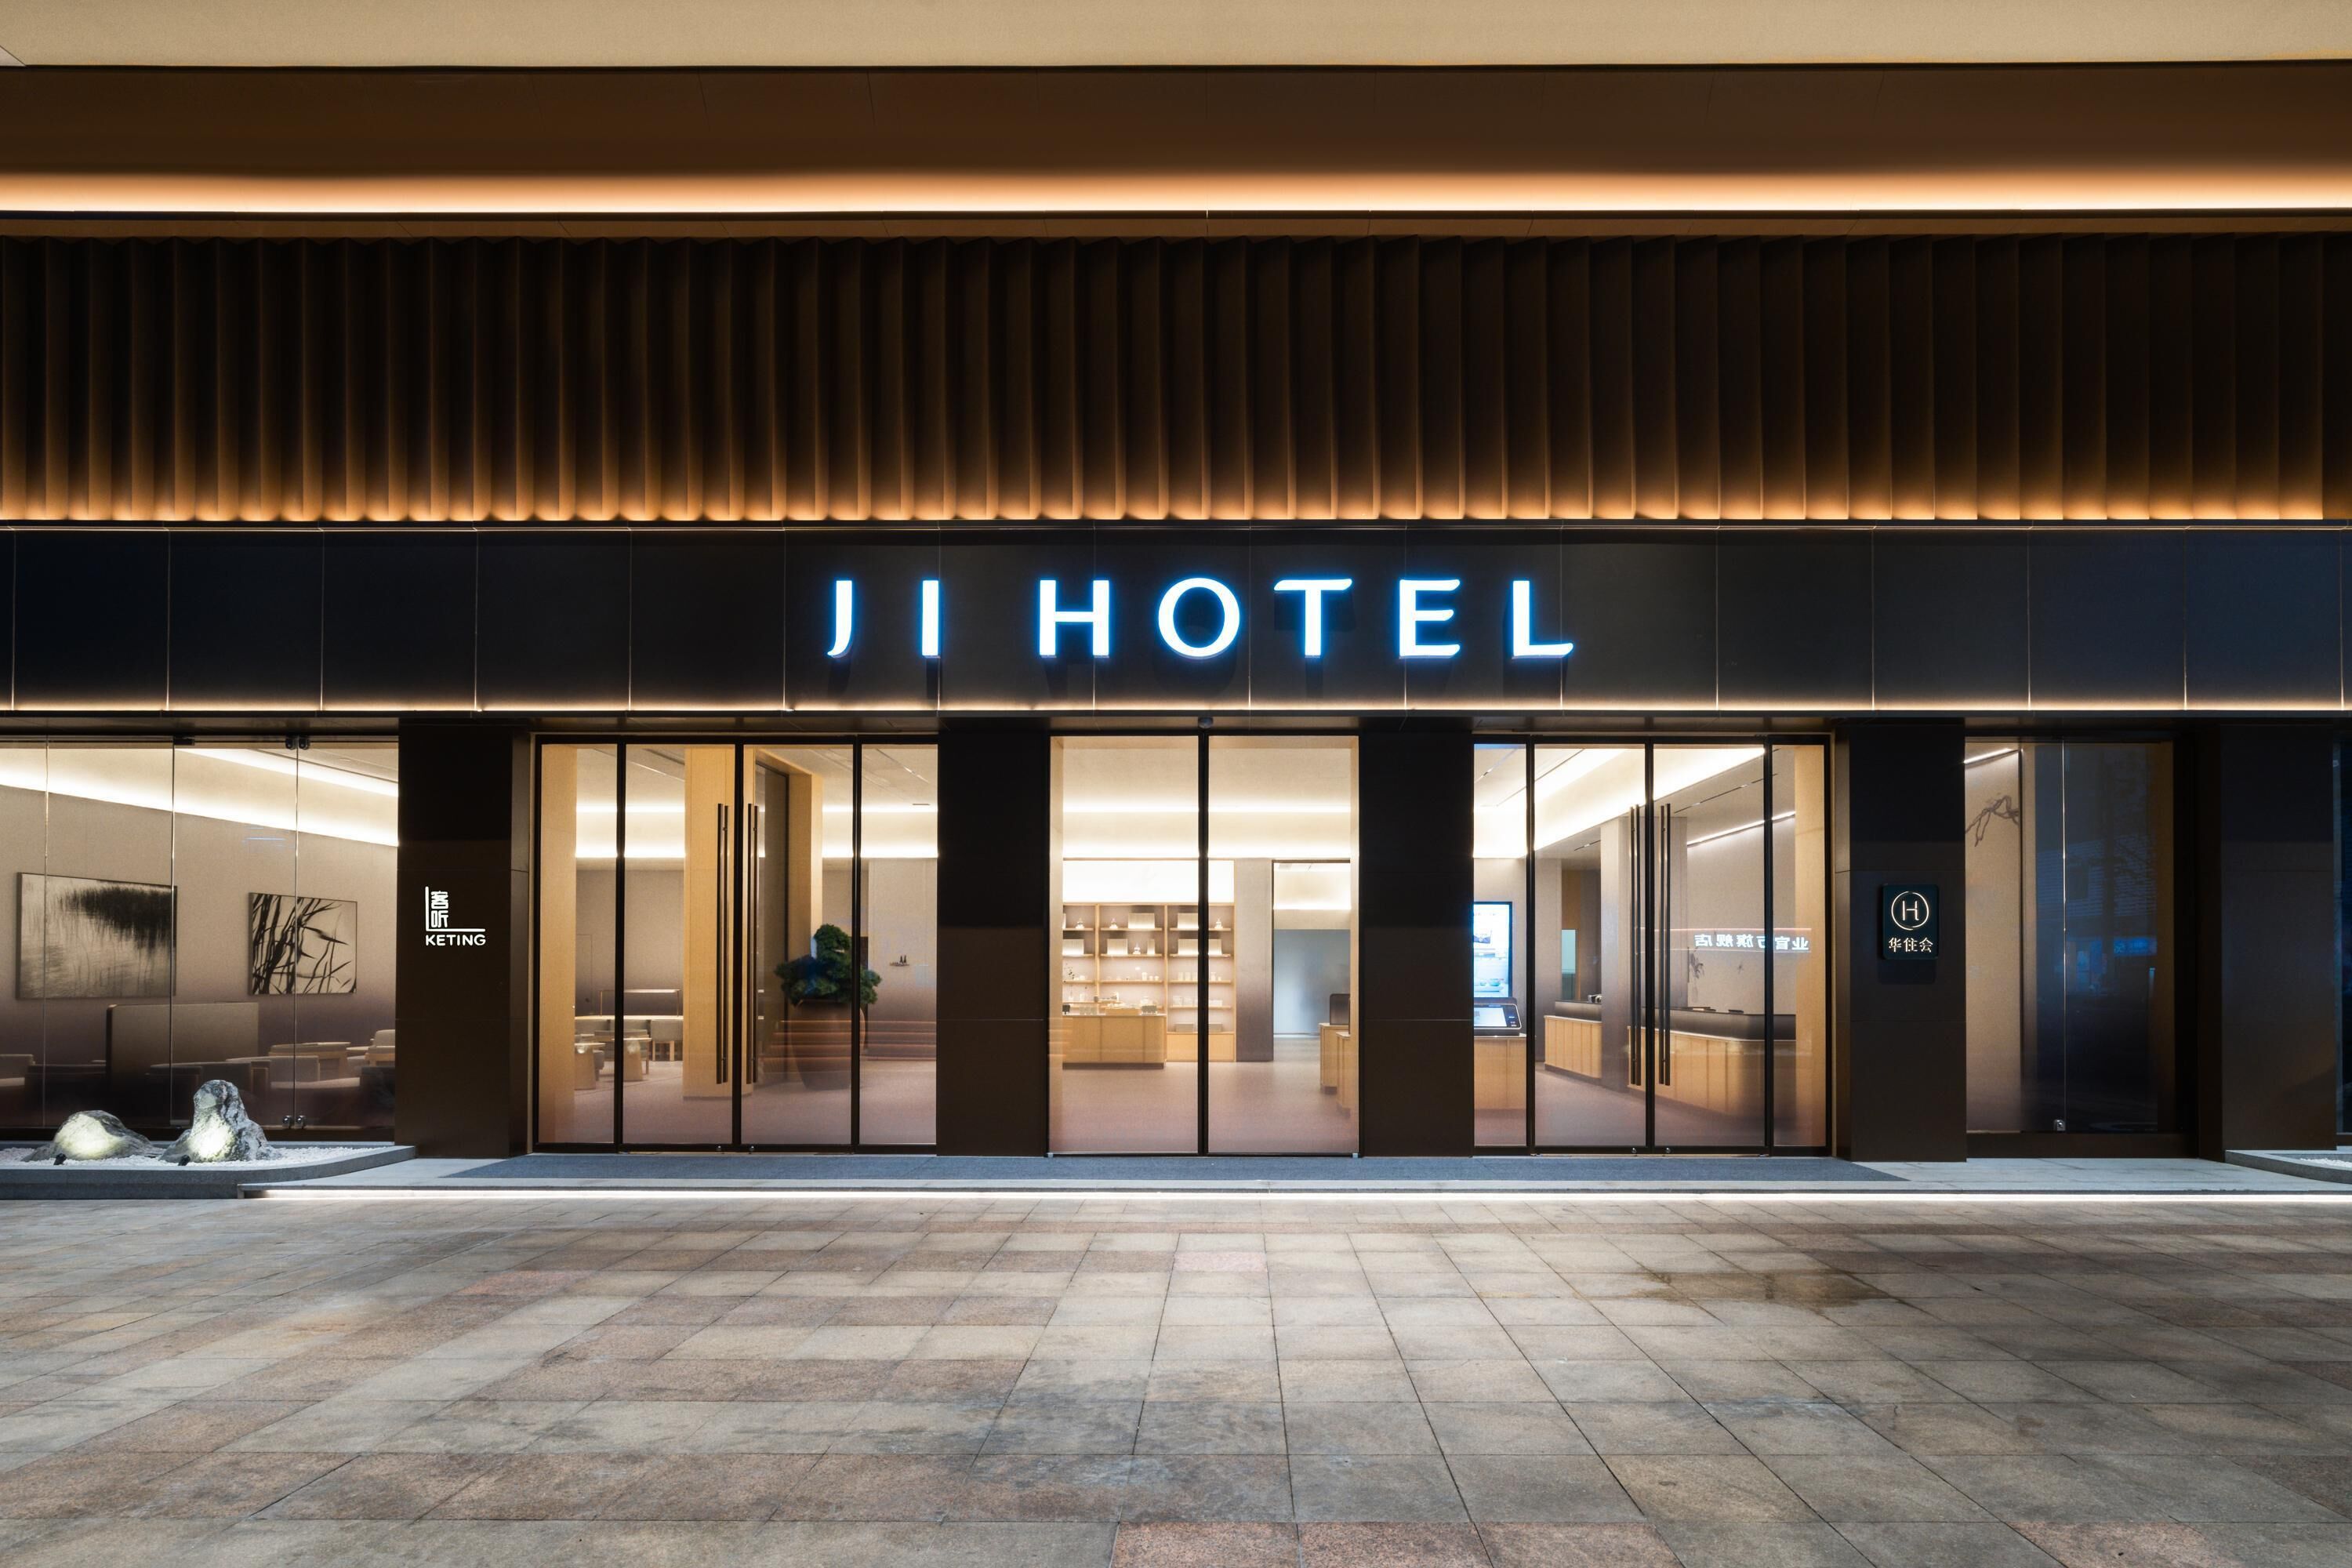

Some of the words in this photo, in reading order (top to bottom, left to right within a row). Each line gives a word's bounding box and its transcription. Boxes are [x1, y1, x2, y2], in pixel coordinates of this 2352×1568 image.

[828, 579, 939, 658] JI
[1038, 578, 1574, 659] HOTEL
[1902, 900, 1919, 921] H
[426, 934, 486, 946] KETING
[1889, 937, 1933, 953] 华住会
